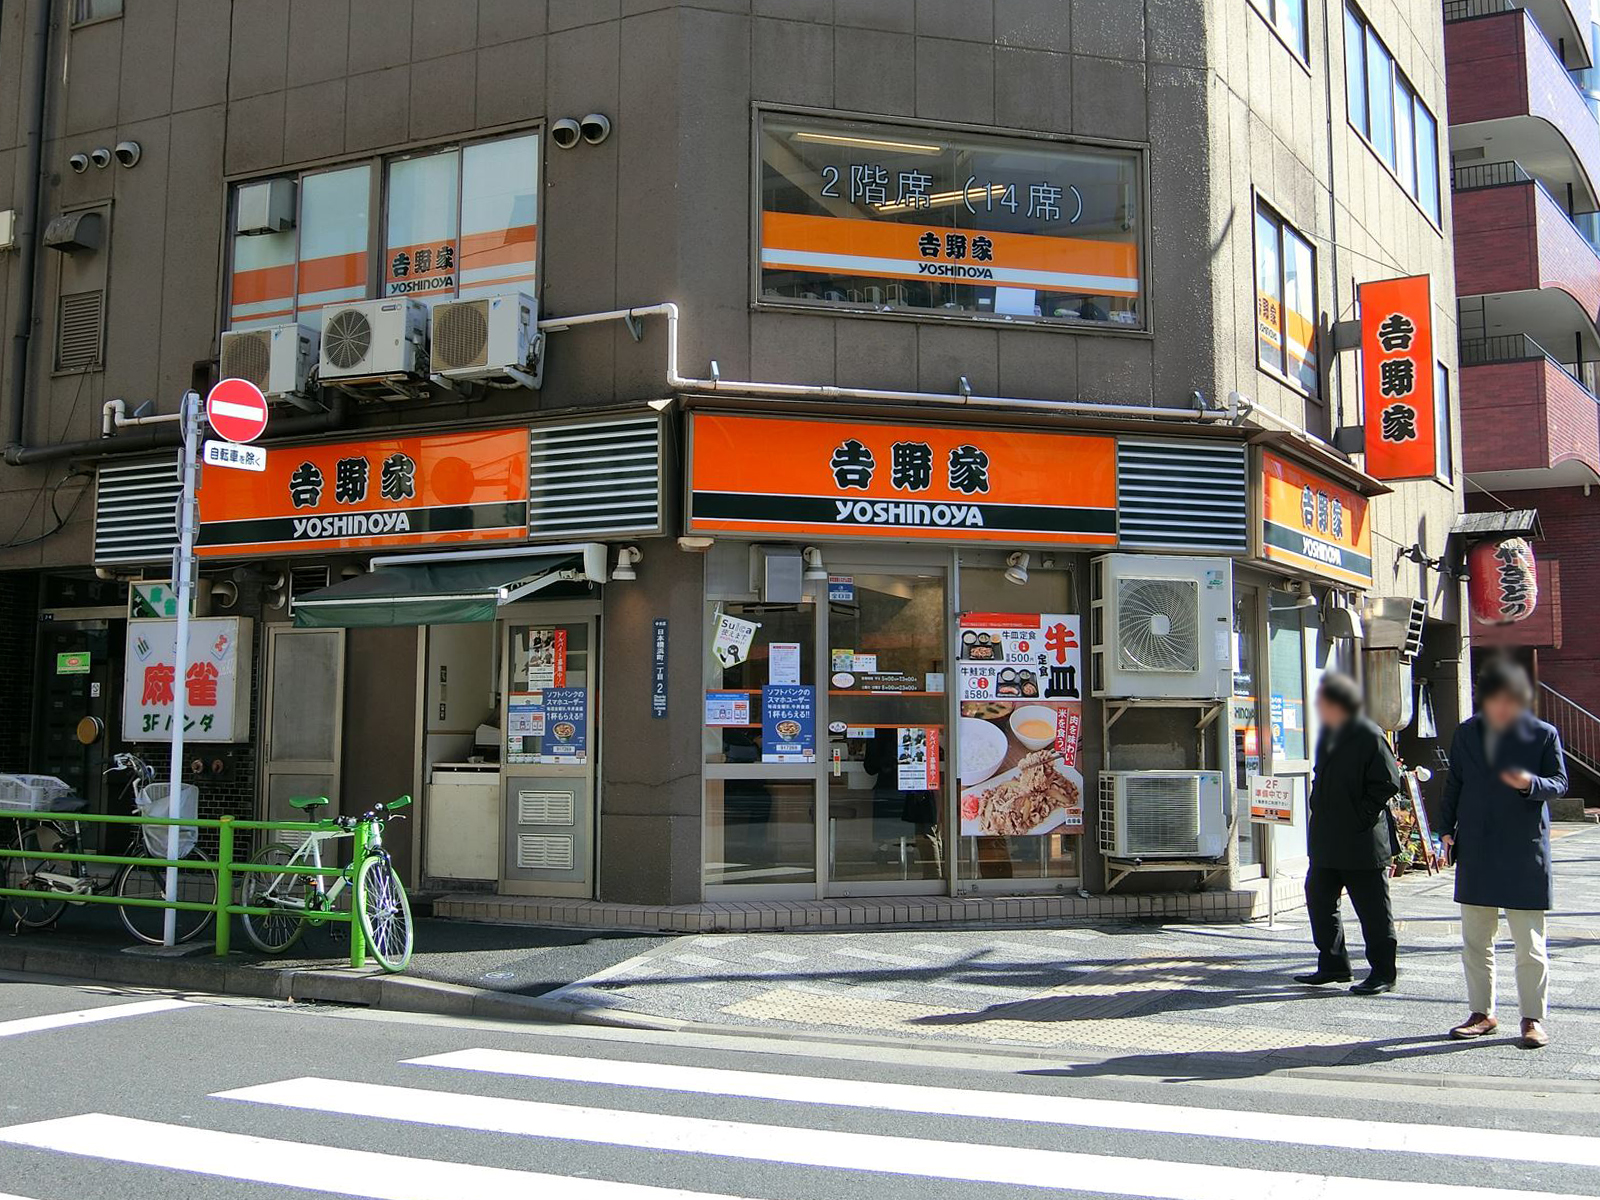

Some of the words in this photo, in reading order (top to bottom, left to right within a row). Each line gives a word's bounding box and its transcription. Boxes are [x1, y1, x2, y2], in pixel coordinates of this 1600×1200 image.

[821, 164, 934, 209] 2階席
[917, 263, 994, 280] YOSHINOYA
[391, 276, 454, 293] YOSHINOYA
[210, 446, 261, 467] 自転車を除く
[834, 500, 985, 527] YOSHINOYA
[293, 512, 411, 539] YOSHINOYA
[721, 618, 753, 635] Suica
[1037, 653, 1049, 677] 定食
[141, 662, 219, 707] 麻雀
[656, 683, 664, 694] 2
[767, 688, 811, 696] ソフトバンクの
[546, 690, 585, 698] ソフトバンクの
[546, 698, 584, 706] スマホユーザー
[767, 696, 811, 704] スマホユーザー
[142, 713, 160, 732] 3F
[1265, 779, 1279, 789] 2F
